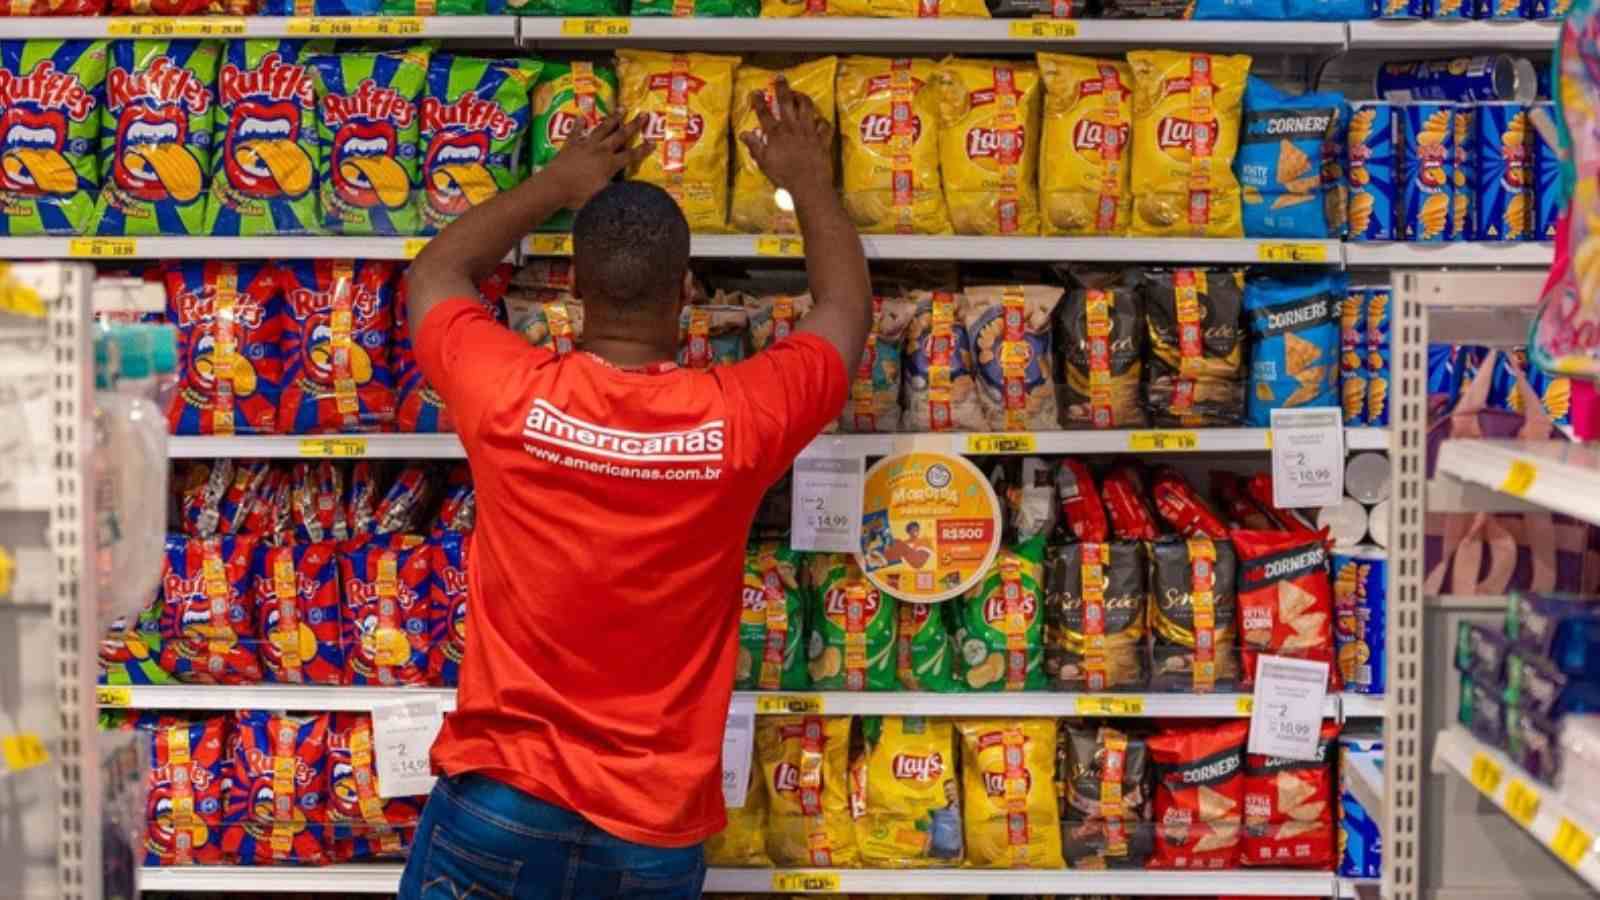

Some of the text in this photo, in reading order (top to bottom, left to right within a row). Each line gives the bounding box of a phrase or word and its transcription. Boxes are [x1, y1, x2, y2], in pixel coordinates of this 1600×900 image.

[322, 78, 418, 128] Ruffles
[417, 91, 518, 139] Ruffles
[525, 406, 725, 456] americanas
[522, 442, 723, 481] www.americanas.com.br
[1297, 452, 1305, 466] 2
[816, 498, 825, 511] 2
[895, 752, 944, 782] Lay's
